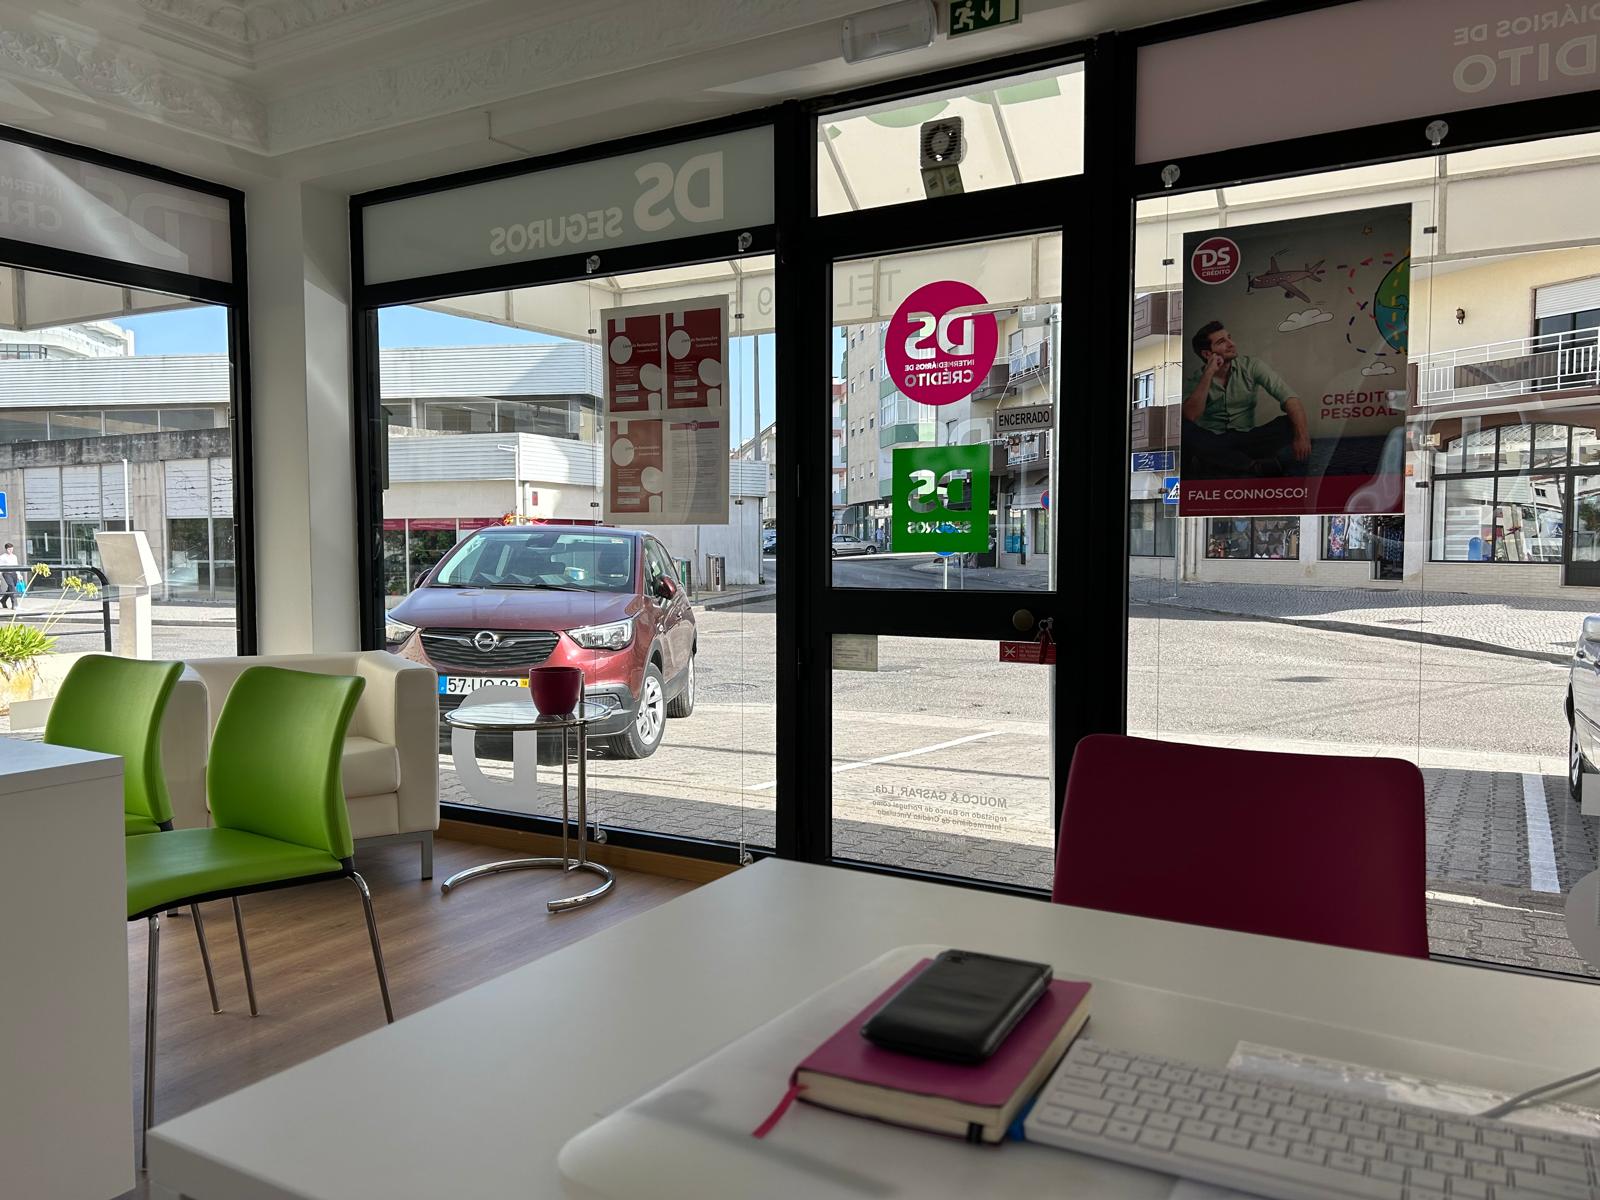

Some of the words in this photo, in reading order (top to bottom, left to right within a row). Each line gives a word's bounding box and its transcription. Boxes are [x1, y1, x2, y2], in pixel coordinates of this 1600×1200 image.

[1201, 247, 1231, 267] DS
[998, 410, 1050, 427] ENCERRADO
[1320, 406, 1398, 420] PESSOAL
[1188, 489, 1221, 501] FALE
[1224, 487, 1308, 500] CONNOSCO!
